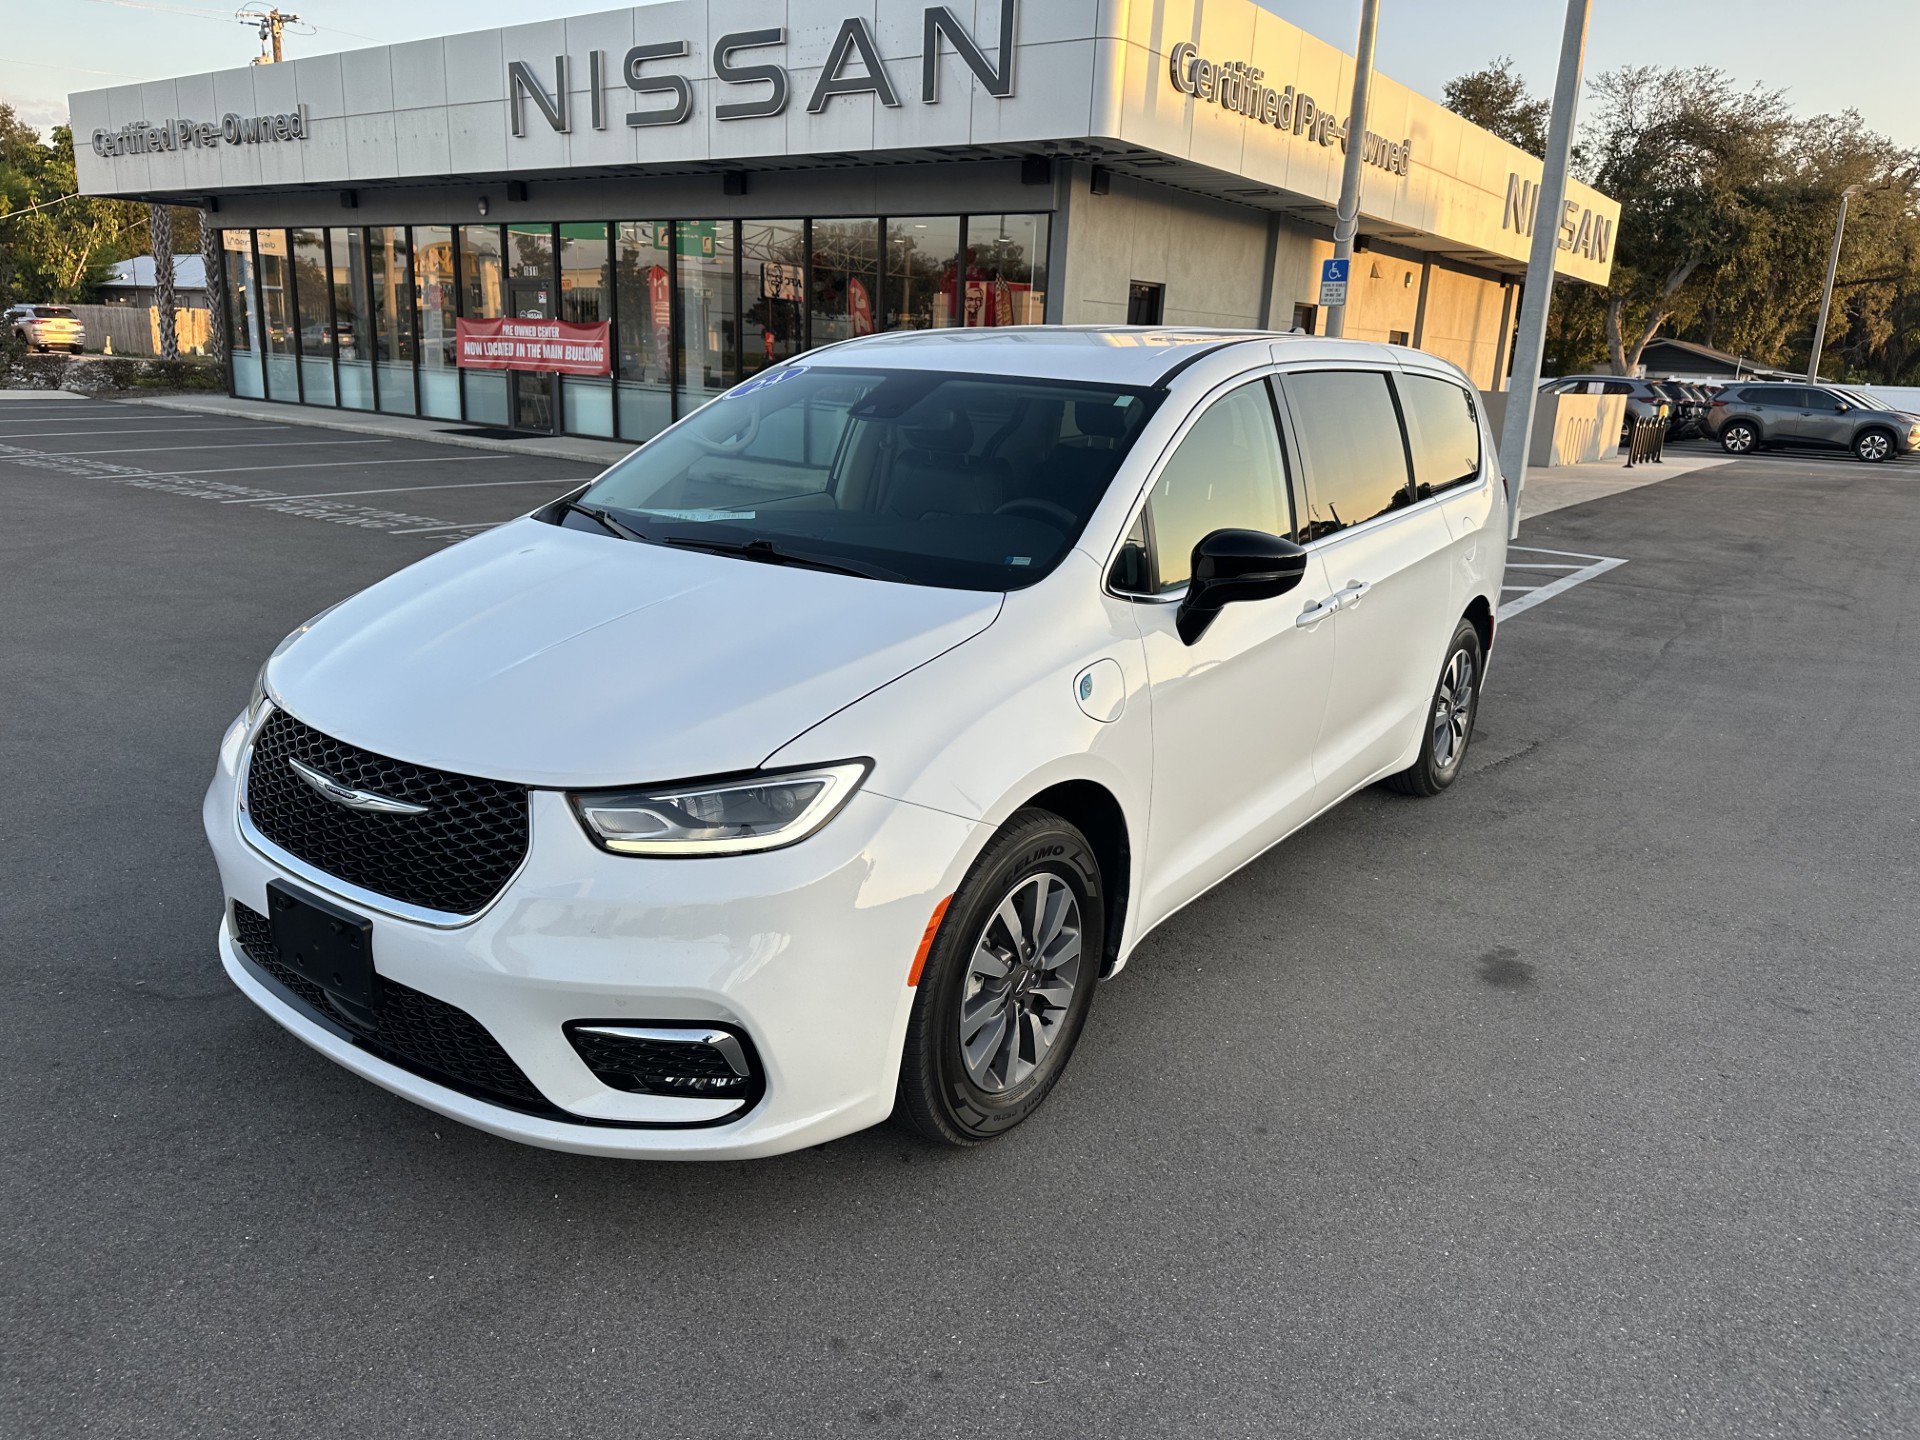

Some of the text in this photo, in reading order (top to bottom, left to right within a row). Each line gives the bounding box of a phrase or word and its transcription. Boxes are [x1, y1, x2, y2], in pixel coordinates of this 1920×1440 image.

[508, 0, 1016, 137] NISSAN
[1170, 41, 1412, 176] Certified Pre-wned
[91, 103, 307, 157] Certified Pre-Owned
[1502, 172, 1612, 264] NISAN
[464, 341, 604, 362] NOW LOCATED IN THE MAIN BUILDING
[502, 325, 560, 338] PRE OWNED CENTER
[250, 503, 399, 528] PARKING
[286, 498, 456, 526] CUSTOMER
